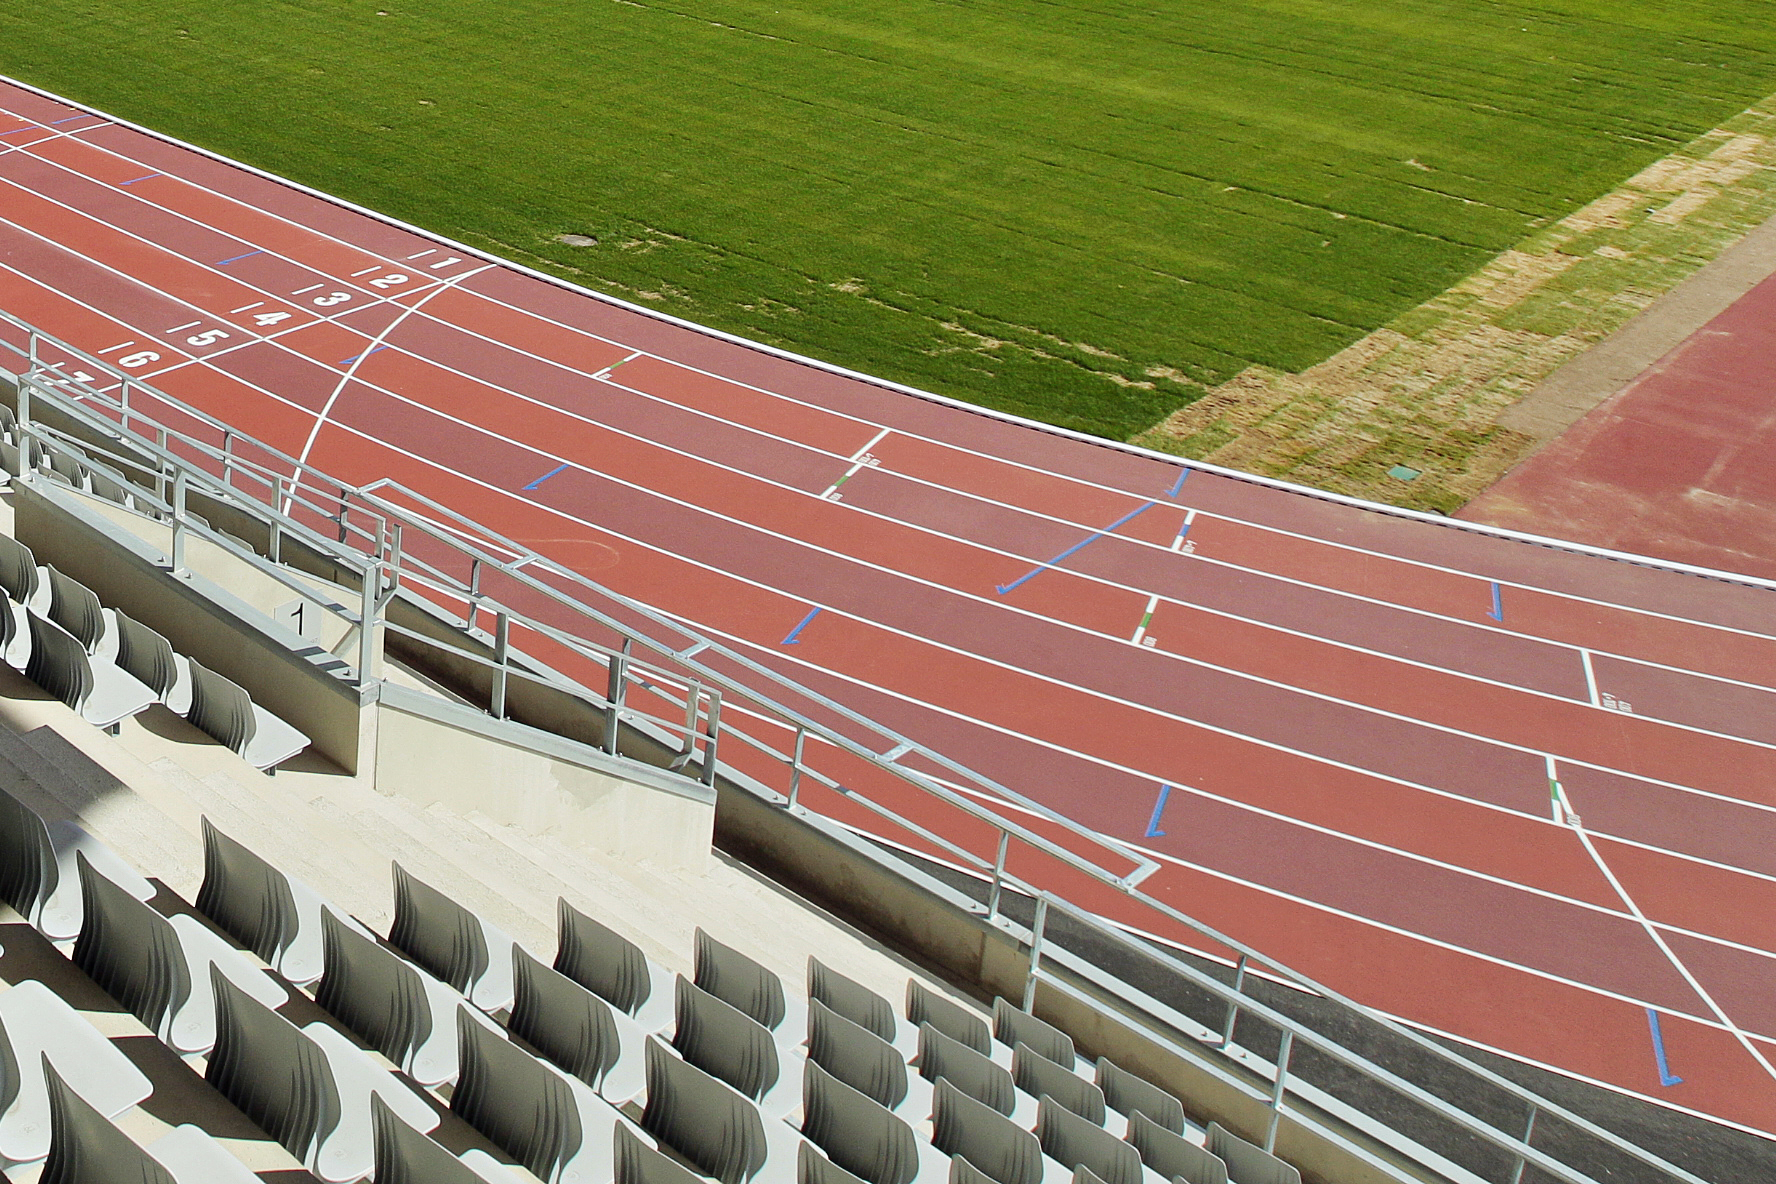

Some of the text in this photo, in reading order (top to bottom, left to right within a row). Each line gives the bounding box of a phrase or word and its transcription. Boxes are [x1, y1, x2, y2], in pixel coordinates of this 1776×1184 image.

[429, 256, 462, 270] 1
[368, 273, 409, 289] 2
[313, 291, 352, 307] 3
[252, 311, 292, 327] 4
[187, 328, 230, 347] 5
[118, 350, 161, 368] 6
[290, 602, 304, 636] 1
